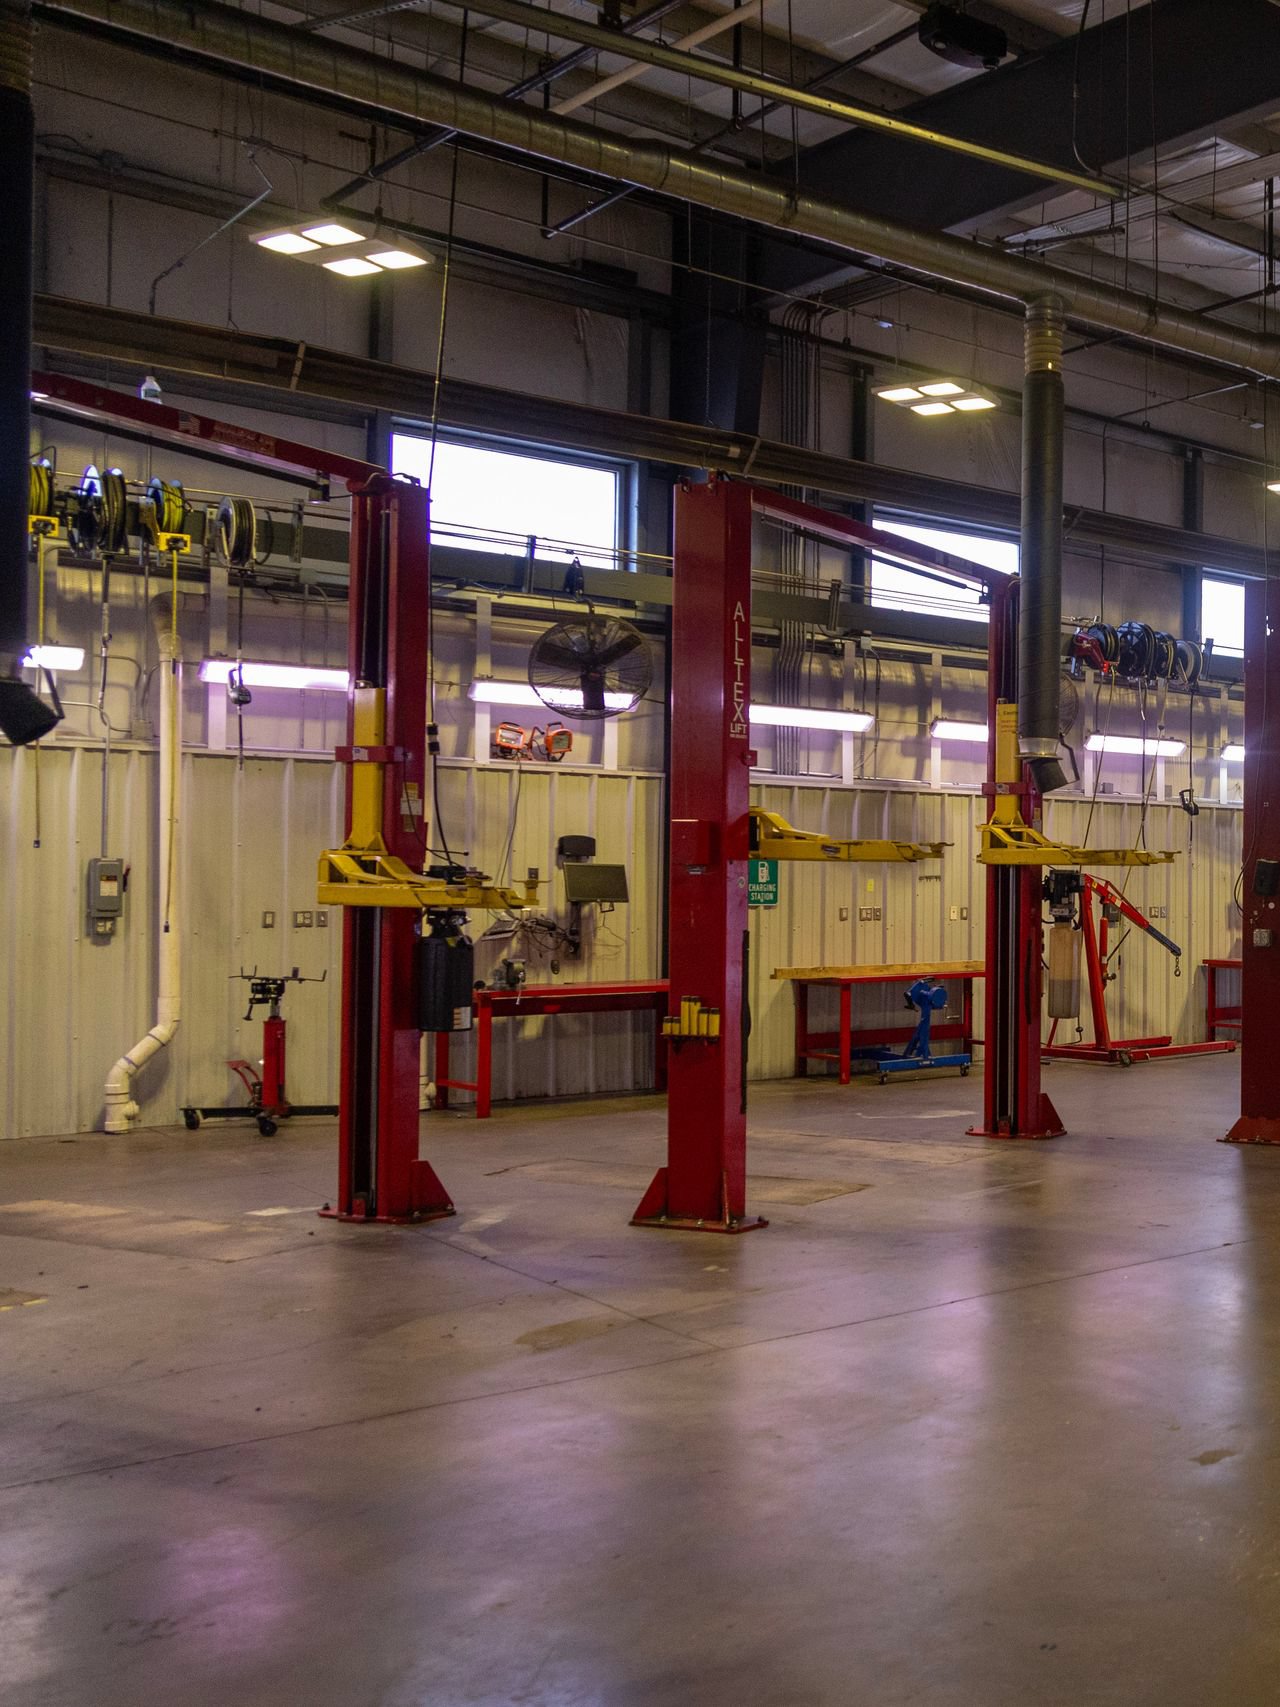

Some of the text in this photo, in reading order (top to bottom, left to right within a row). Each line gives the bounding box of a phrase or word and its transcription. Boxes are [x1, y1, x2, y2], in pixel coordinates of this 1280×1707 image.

[733, 601, 745, 722] ALLTEX
[730, 723, 748, 734] LIFT
[749, 883, 776, 892] CHARGING
